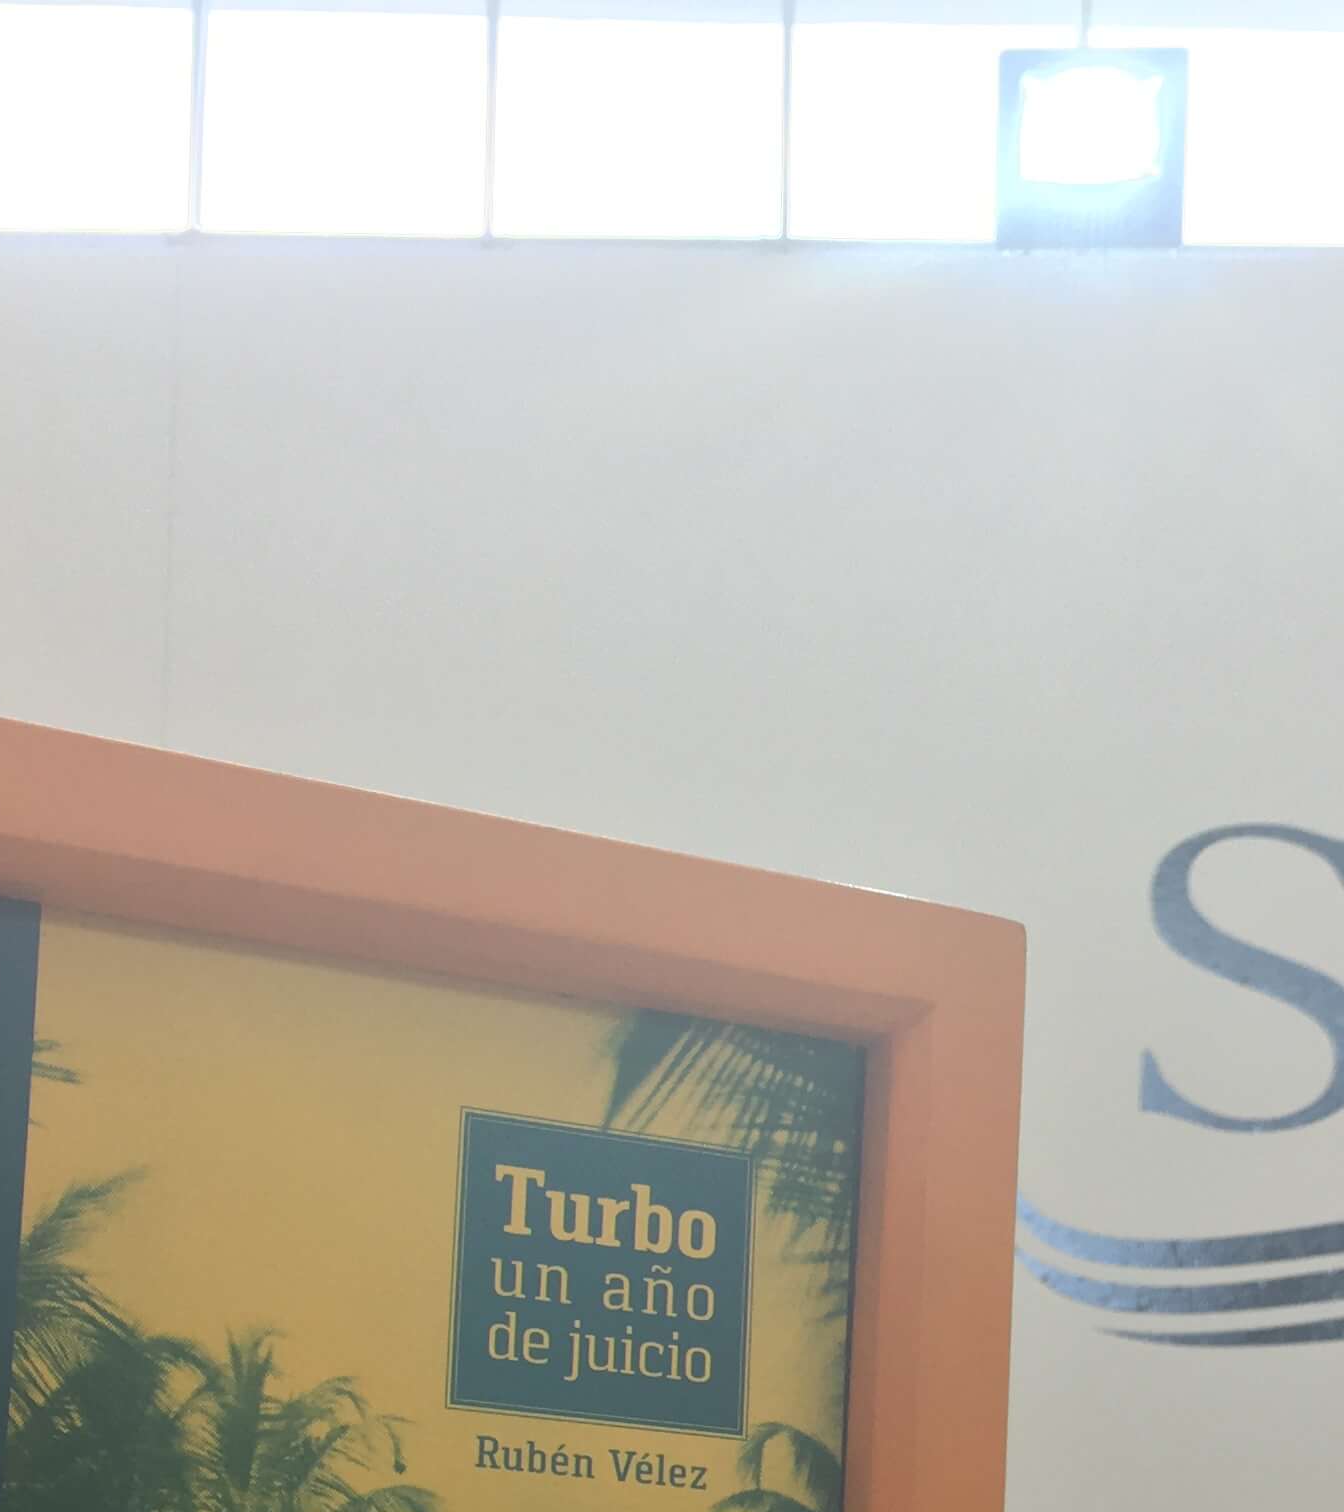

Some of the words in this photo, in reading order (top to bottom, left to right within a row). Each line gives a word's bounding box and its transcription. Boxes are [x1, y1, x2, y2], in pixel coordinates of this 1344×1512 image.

[494, 1163, 718, 1260] Turbo
[489, 1256, 573, 1305] un
[601, 1264, 716, 1322] año
[486, 1310, 551, 1365] de
[563, 1319, 713, 1384] juicio
[474, 1434, 596, 1481] Rubén
[607, 1447, 709, 1492] Vélez
